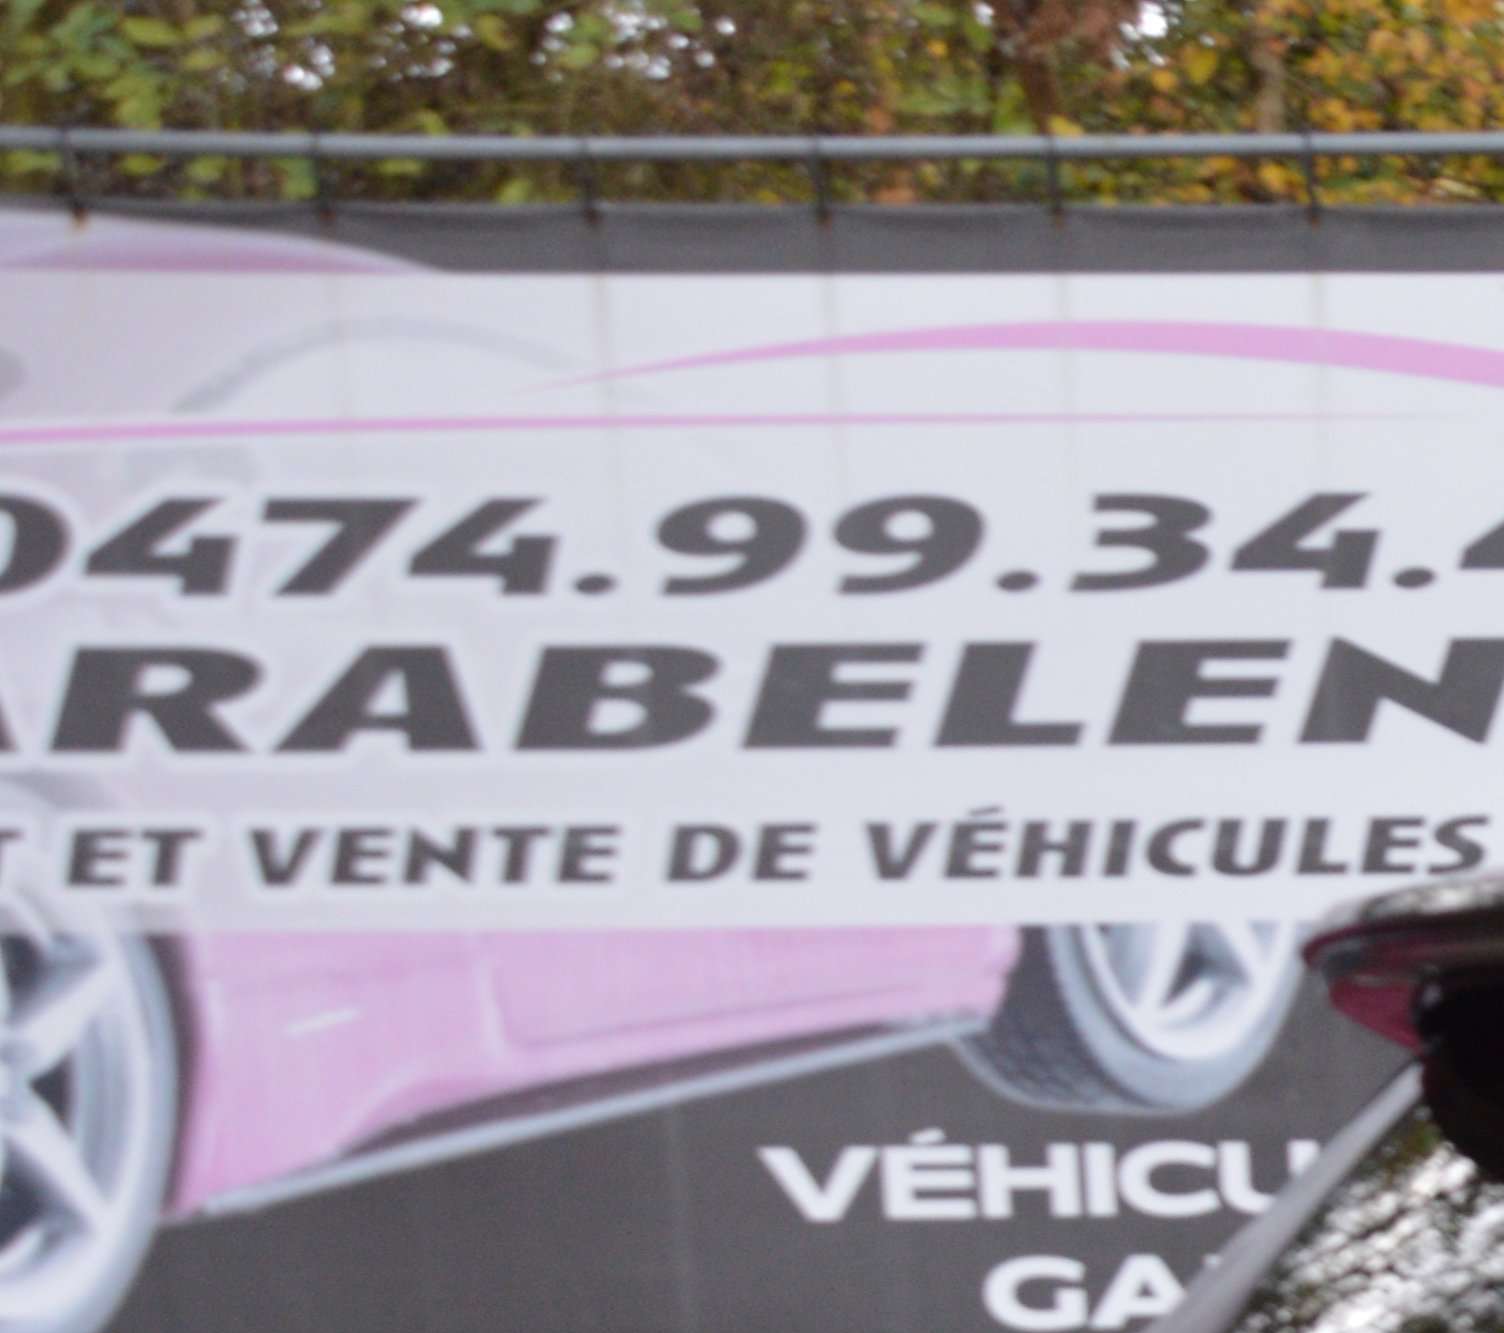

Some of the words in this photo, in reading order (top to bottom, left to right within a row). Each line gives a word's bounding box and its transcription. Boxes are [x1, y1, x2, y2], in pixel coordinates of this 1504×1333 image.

[65, 827, 205, 887] ET
[248, 820, 622, 887] VENTE
[665, 820, 818, 883] DE
[865, 805, 1490, 882] VÉHICULES
[756, 1126, 1321, 1223] VÉHICU
[982, 1252, 1222, 1333] GA
